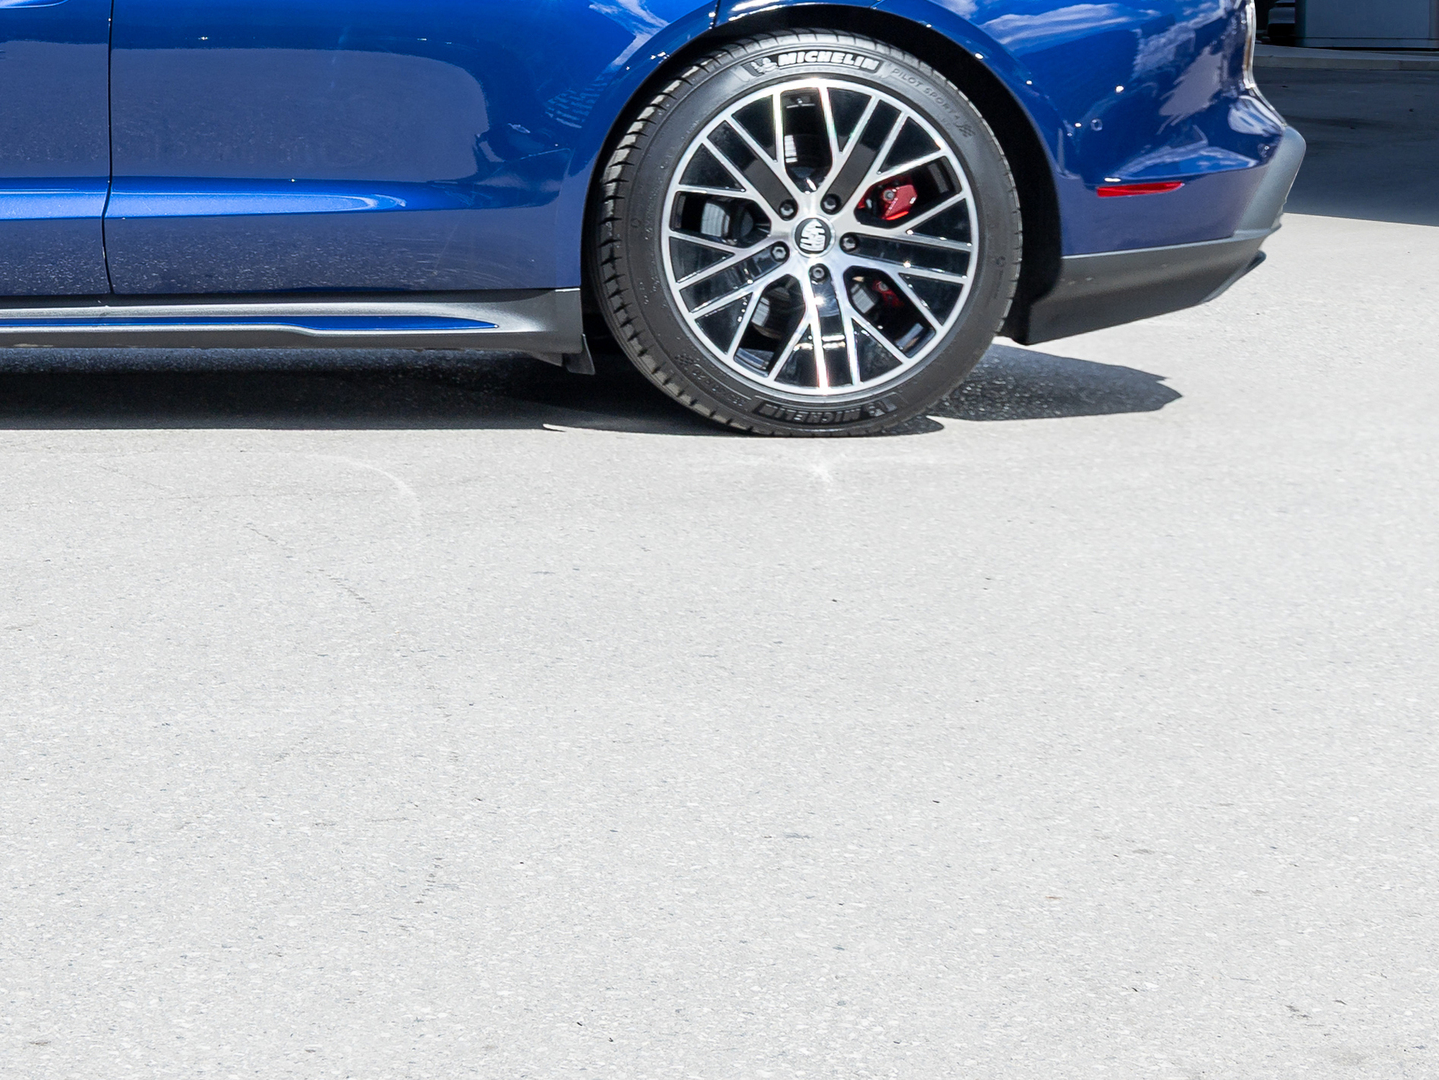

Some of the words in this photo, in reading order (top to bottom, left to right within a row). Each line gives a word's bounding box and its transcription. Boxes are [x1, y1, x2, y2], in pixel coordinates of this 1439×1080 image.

[777, 50, 881, 72] MICHELIN
[892, 68, 923, 88] PILOT
[764, 403, 862, 423] MICHELIN
